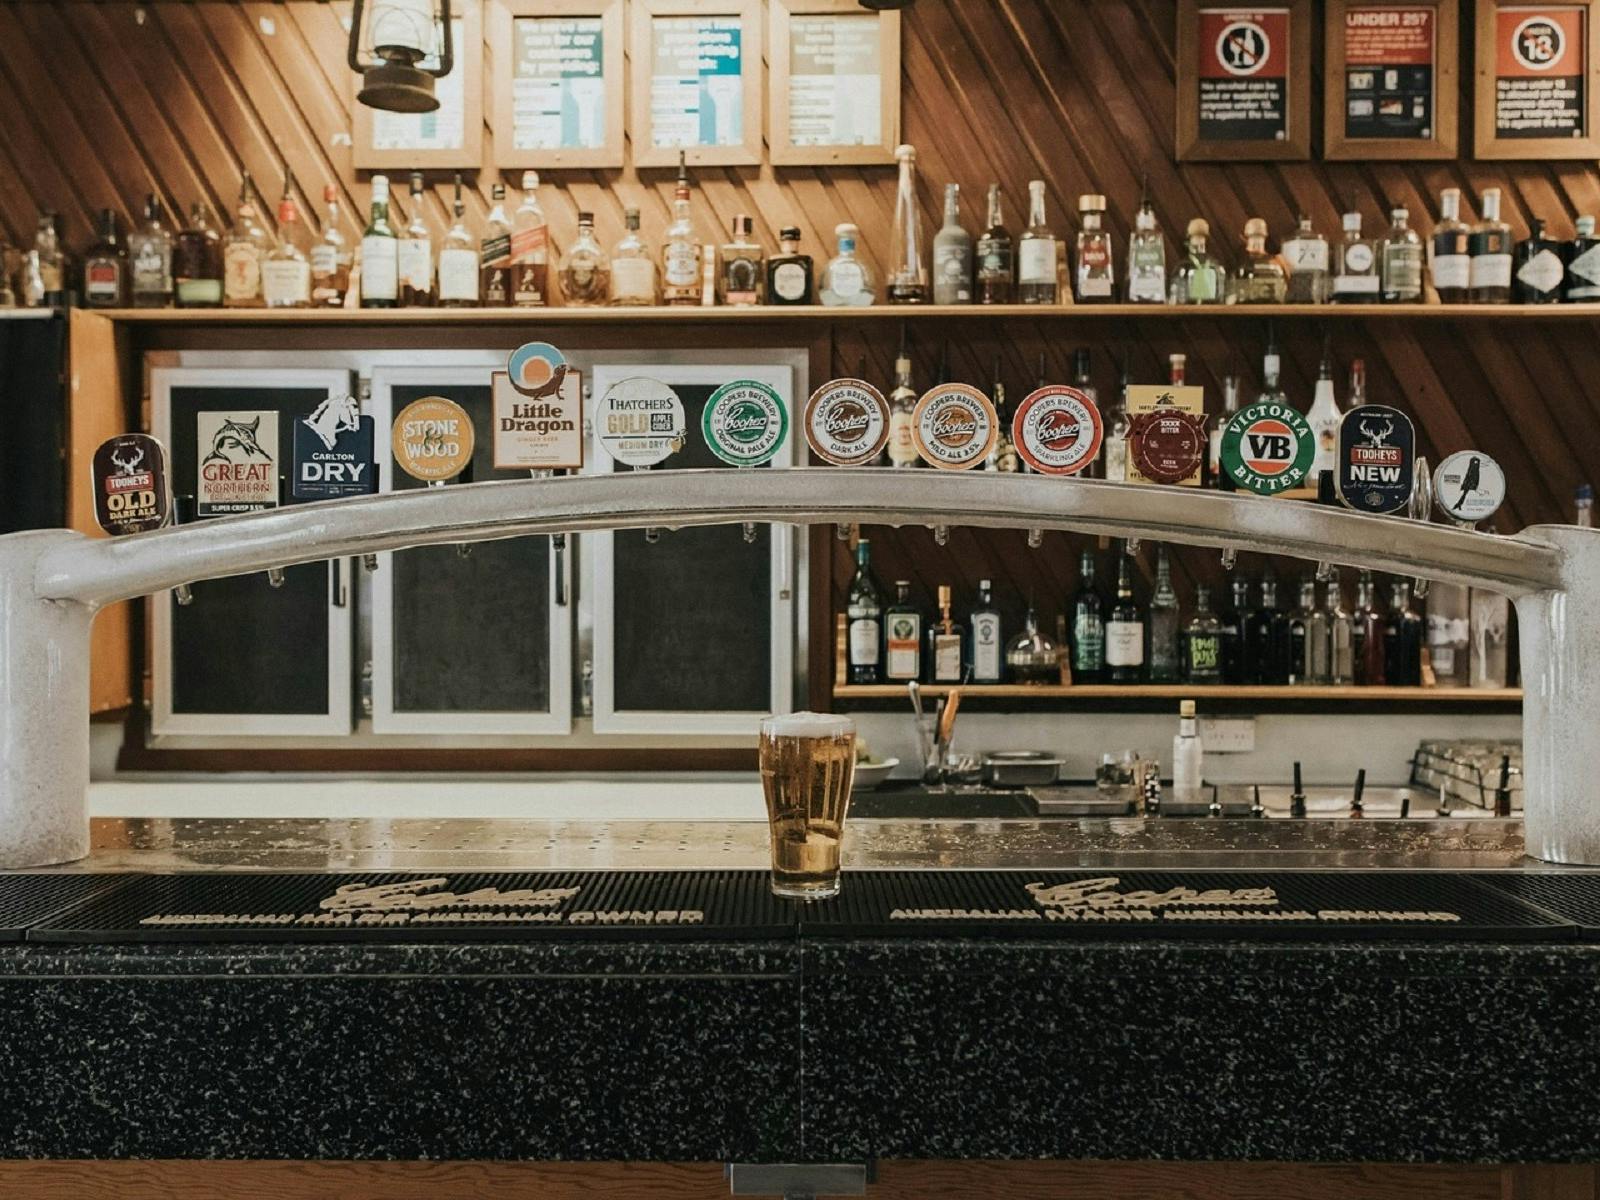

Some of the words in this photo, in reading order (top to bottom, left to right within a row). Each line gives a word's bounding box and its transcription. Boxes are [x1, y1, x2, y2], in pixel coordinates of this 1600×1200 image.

[1346, 12, 1400, 26] UNDER
[513, 404, 563, 418] Little
[716, 390, 747, 416] COOPERS
[748, 390, 777, 417] BREWERY
[816, 390, 845, 419] COOPERS
[847, 390, 878, 414] BREWERY
[925, 394, 955, 420] COOPERS
[956, 395, 985, 421] BREWERY
[1027, 398, 1056, 426] COOPERS
[1057, 399, 1089, 422] BREWERY
[403, 420, 459, 438] STONE
[500, 418, 575, 435] Dragon
[607, 413, 650, 434] GOLD
[1229, 405, 1309, 438] VICTORIA
[406, 442, 459, 458] WOOD
[618, 440, 647, 449] MEDIUM
[648, 440, 664, 449] DRY
[716, 428, 746, 454] ORIGINAL
[747, 443, 766, 454] PALE
[765, 430, 776, 445] ALE
[830, 442, 852, 453] DARK
[854, 441, 868, 451] ALE
[928, 440, 946, 456] MILD
[947, 450, 962, 459] ALE
[1247, 434, 1291, 460] VB
[312, 452, 355, 461] CARLTON
[1033, 445, 1074, 461] SPARKLING
[1074, 443, 1085, 456] ALE
[1355, 449, 1397, 461] TOOHEYS
[203, 463, 271, 481] GREAT
[302, 462, 366, 482] DRY
[1233, 465, 1304, 490] BITTER
[1350, 465, 1401, 482] NEW
[110, 474, 150, 489] TOOHEYS
[204, 482, 270, 494] NORTHERN
[107, 490, 156, 511] OLD
[211, 504, 231, 513] SUPER
[231, 504, 249, 512] CRISP
[109, 508, 136, 520] DARK
[138, 506, 156, 516] ALE
